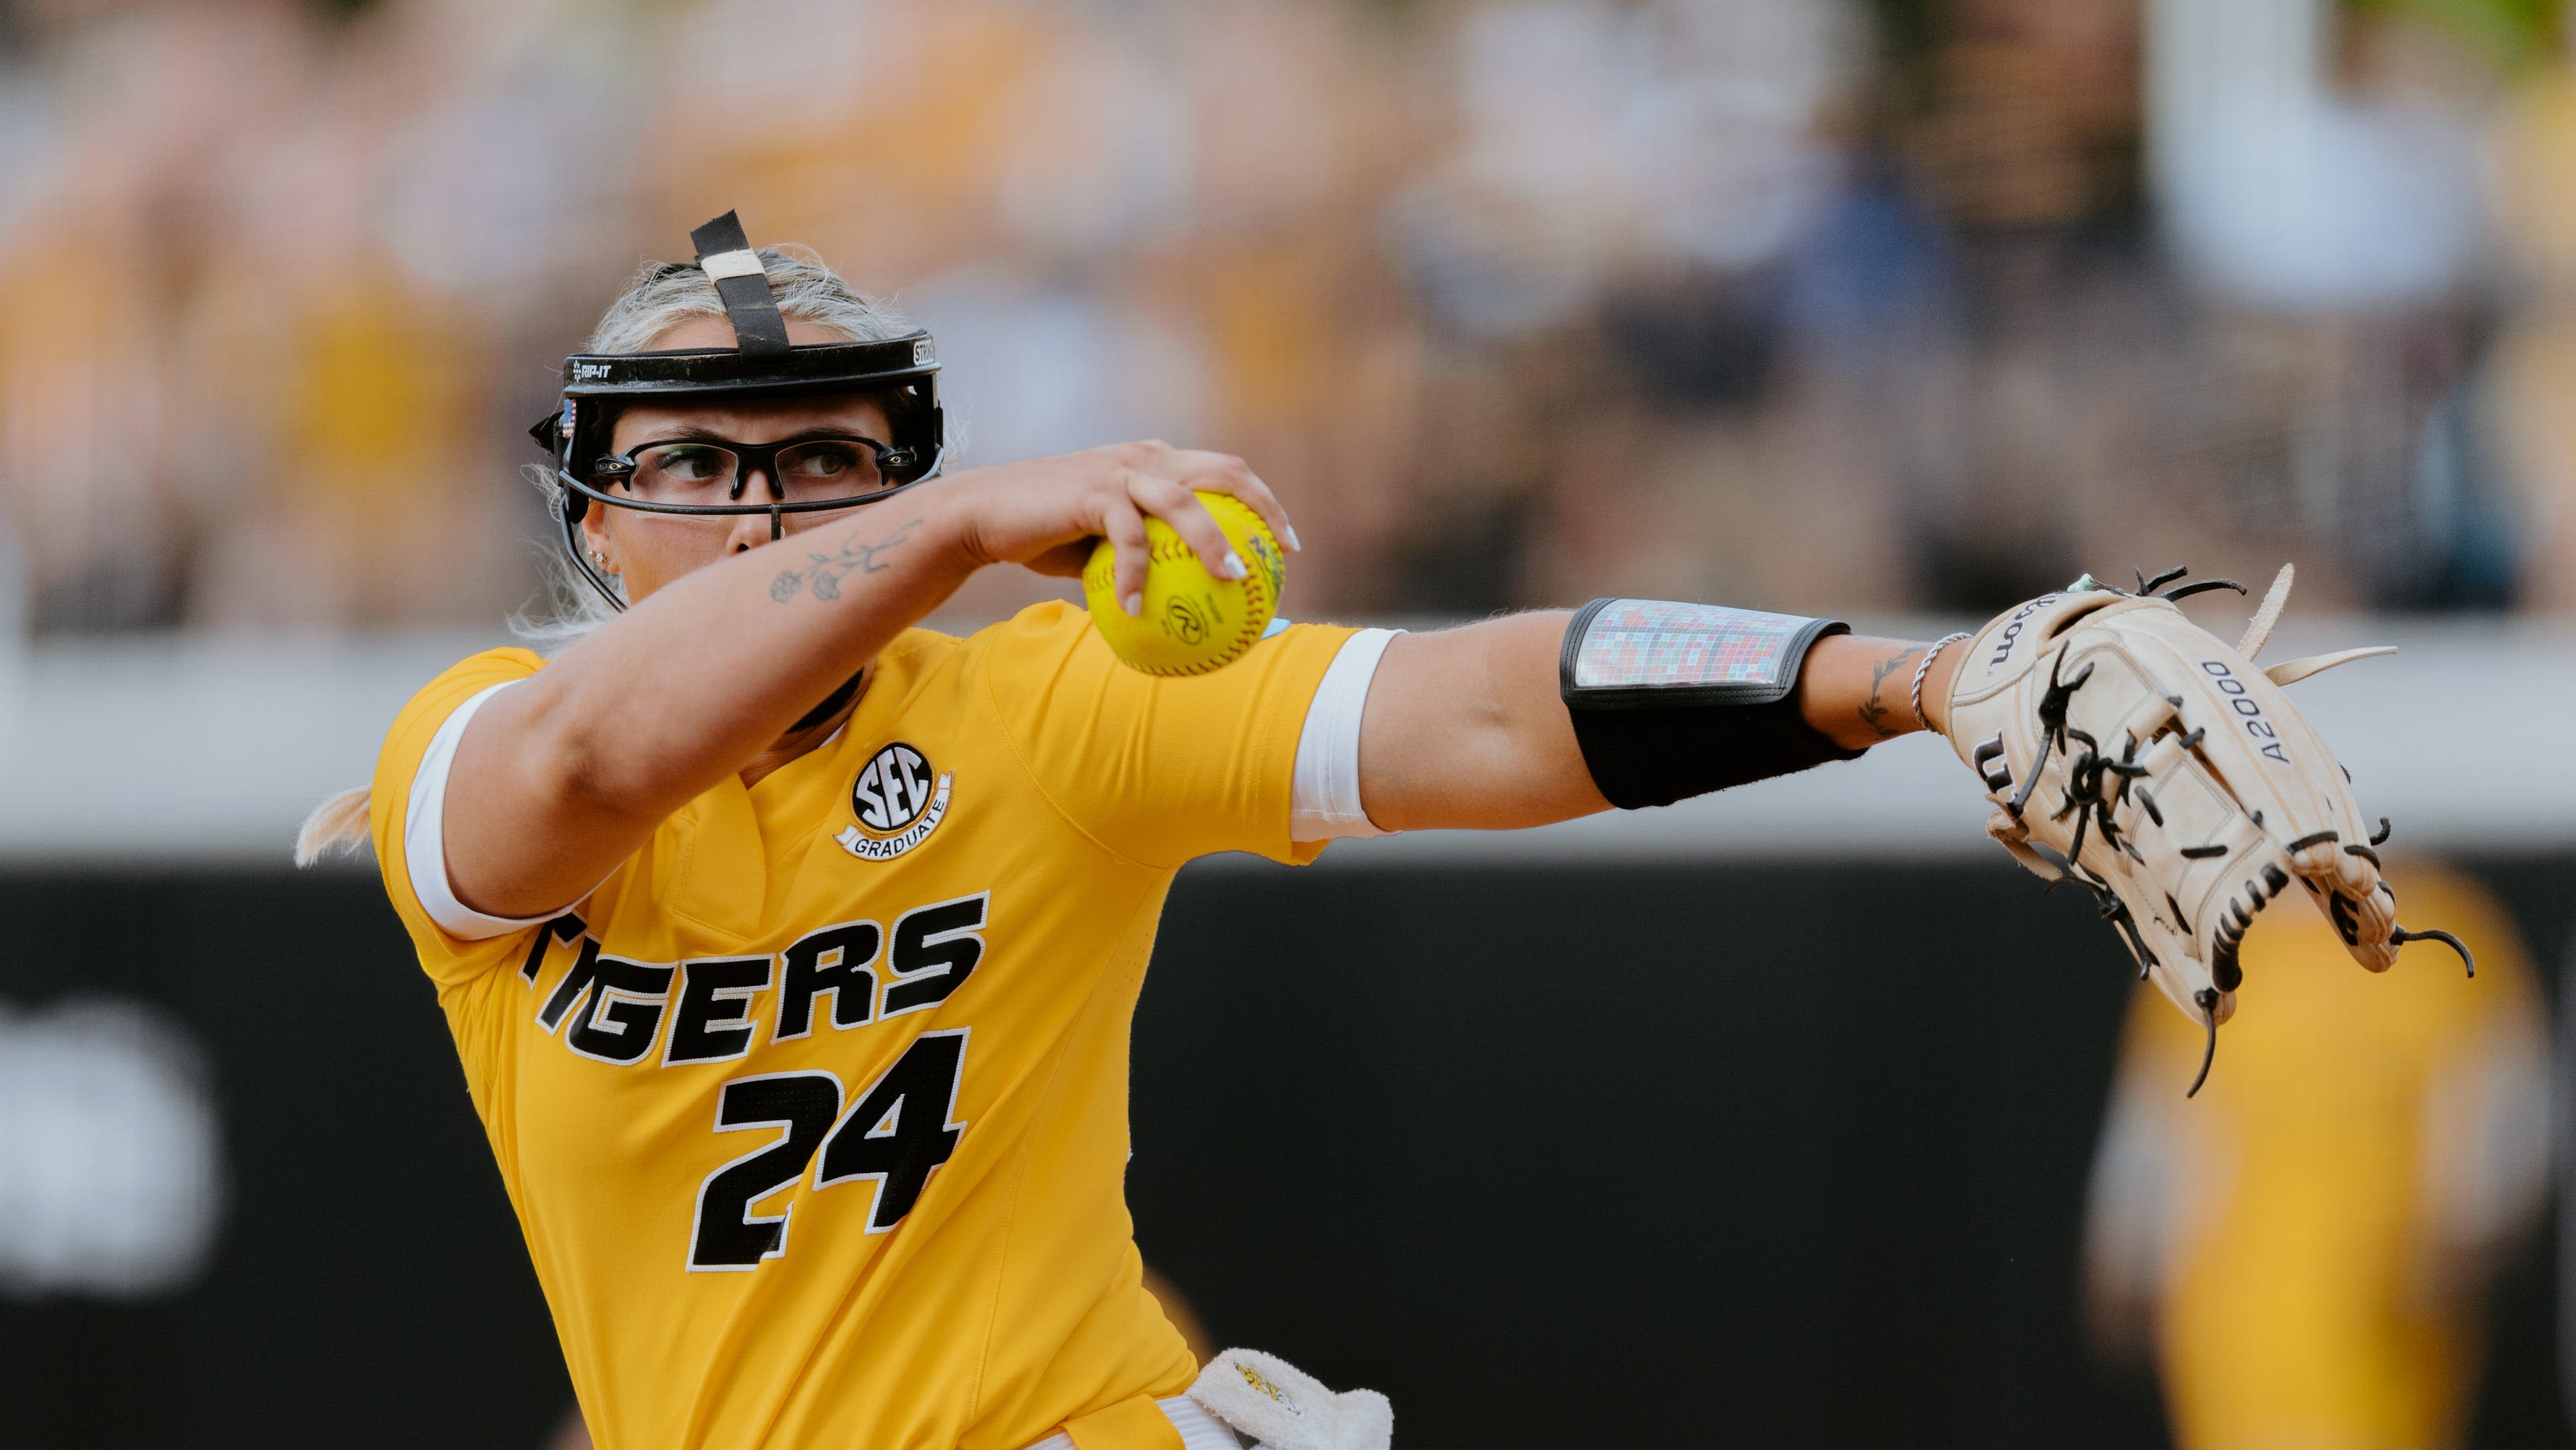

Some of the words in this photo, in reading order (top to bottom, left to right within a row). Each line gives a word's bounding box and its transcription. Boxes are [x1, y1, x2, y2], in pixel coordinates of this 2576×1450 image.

[581, 365, 612, 378] RIP-IT
[2201, 661, 2290, 763] A2000
[854, 799, 944, 857] GRADUATE
[856, 746, 929, 828] SEC
[518, 889, 991, 1068] TIGERS
[685, 1026, 972, 1273] 24
